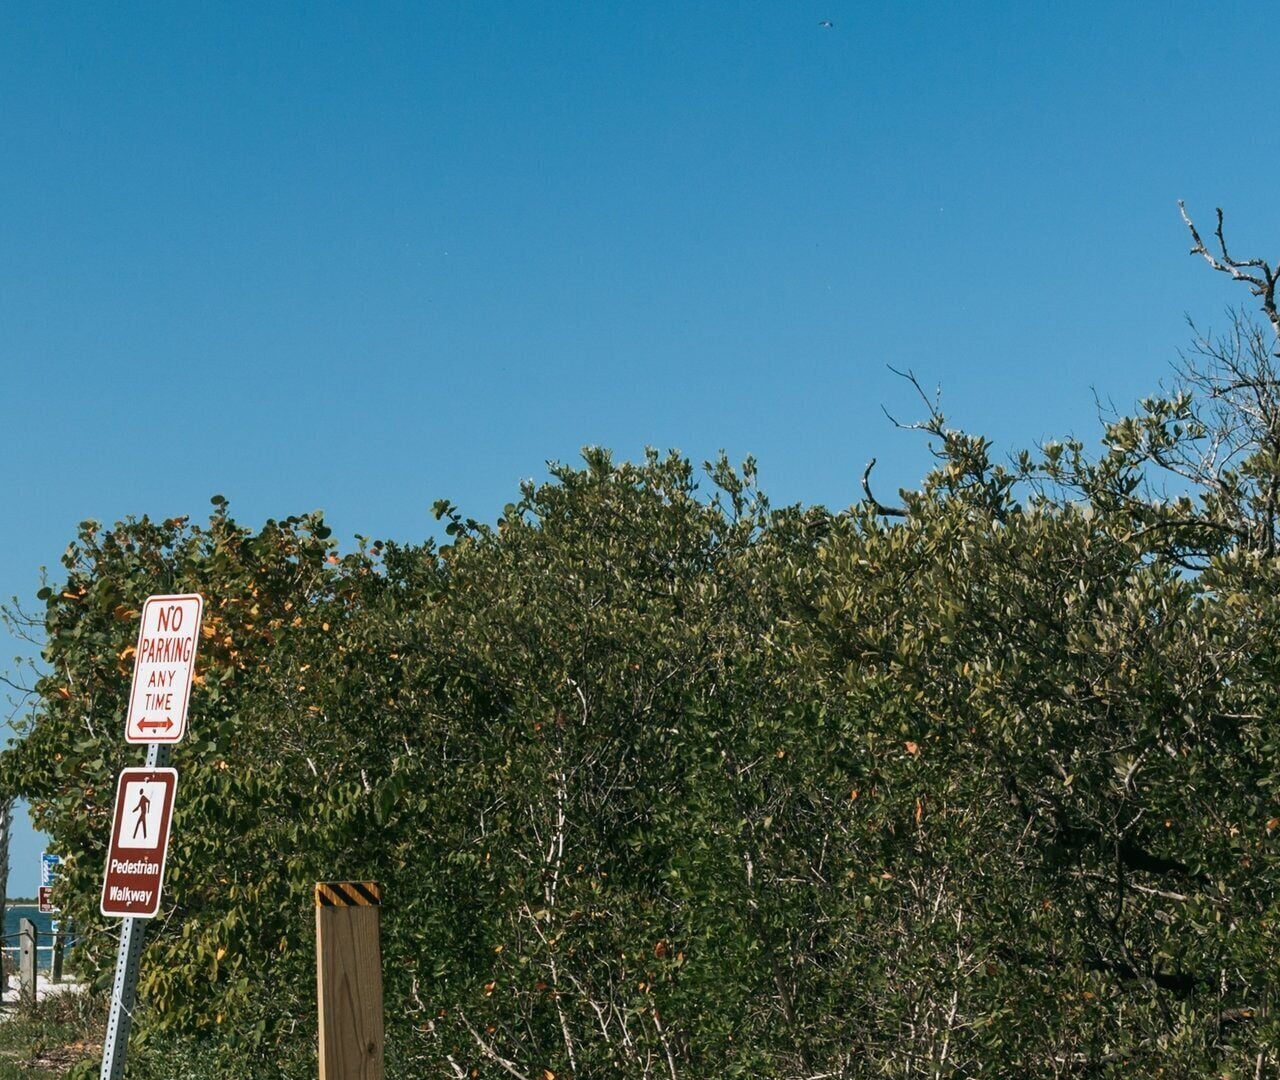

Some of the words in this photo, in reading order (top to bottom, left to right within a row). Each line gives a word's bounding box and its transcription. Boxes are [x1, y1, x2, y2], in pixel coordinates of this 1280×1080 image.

[157, 606, 183, 632] NO
[140, 636, 192, 663] PARKING
[147, 670, 176, 688] ANY
[145, 693, 173, 711] TIME
[110, 859, 159, 875] Pedestrian
[109, 886, 153, 906] Walkway
